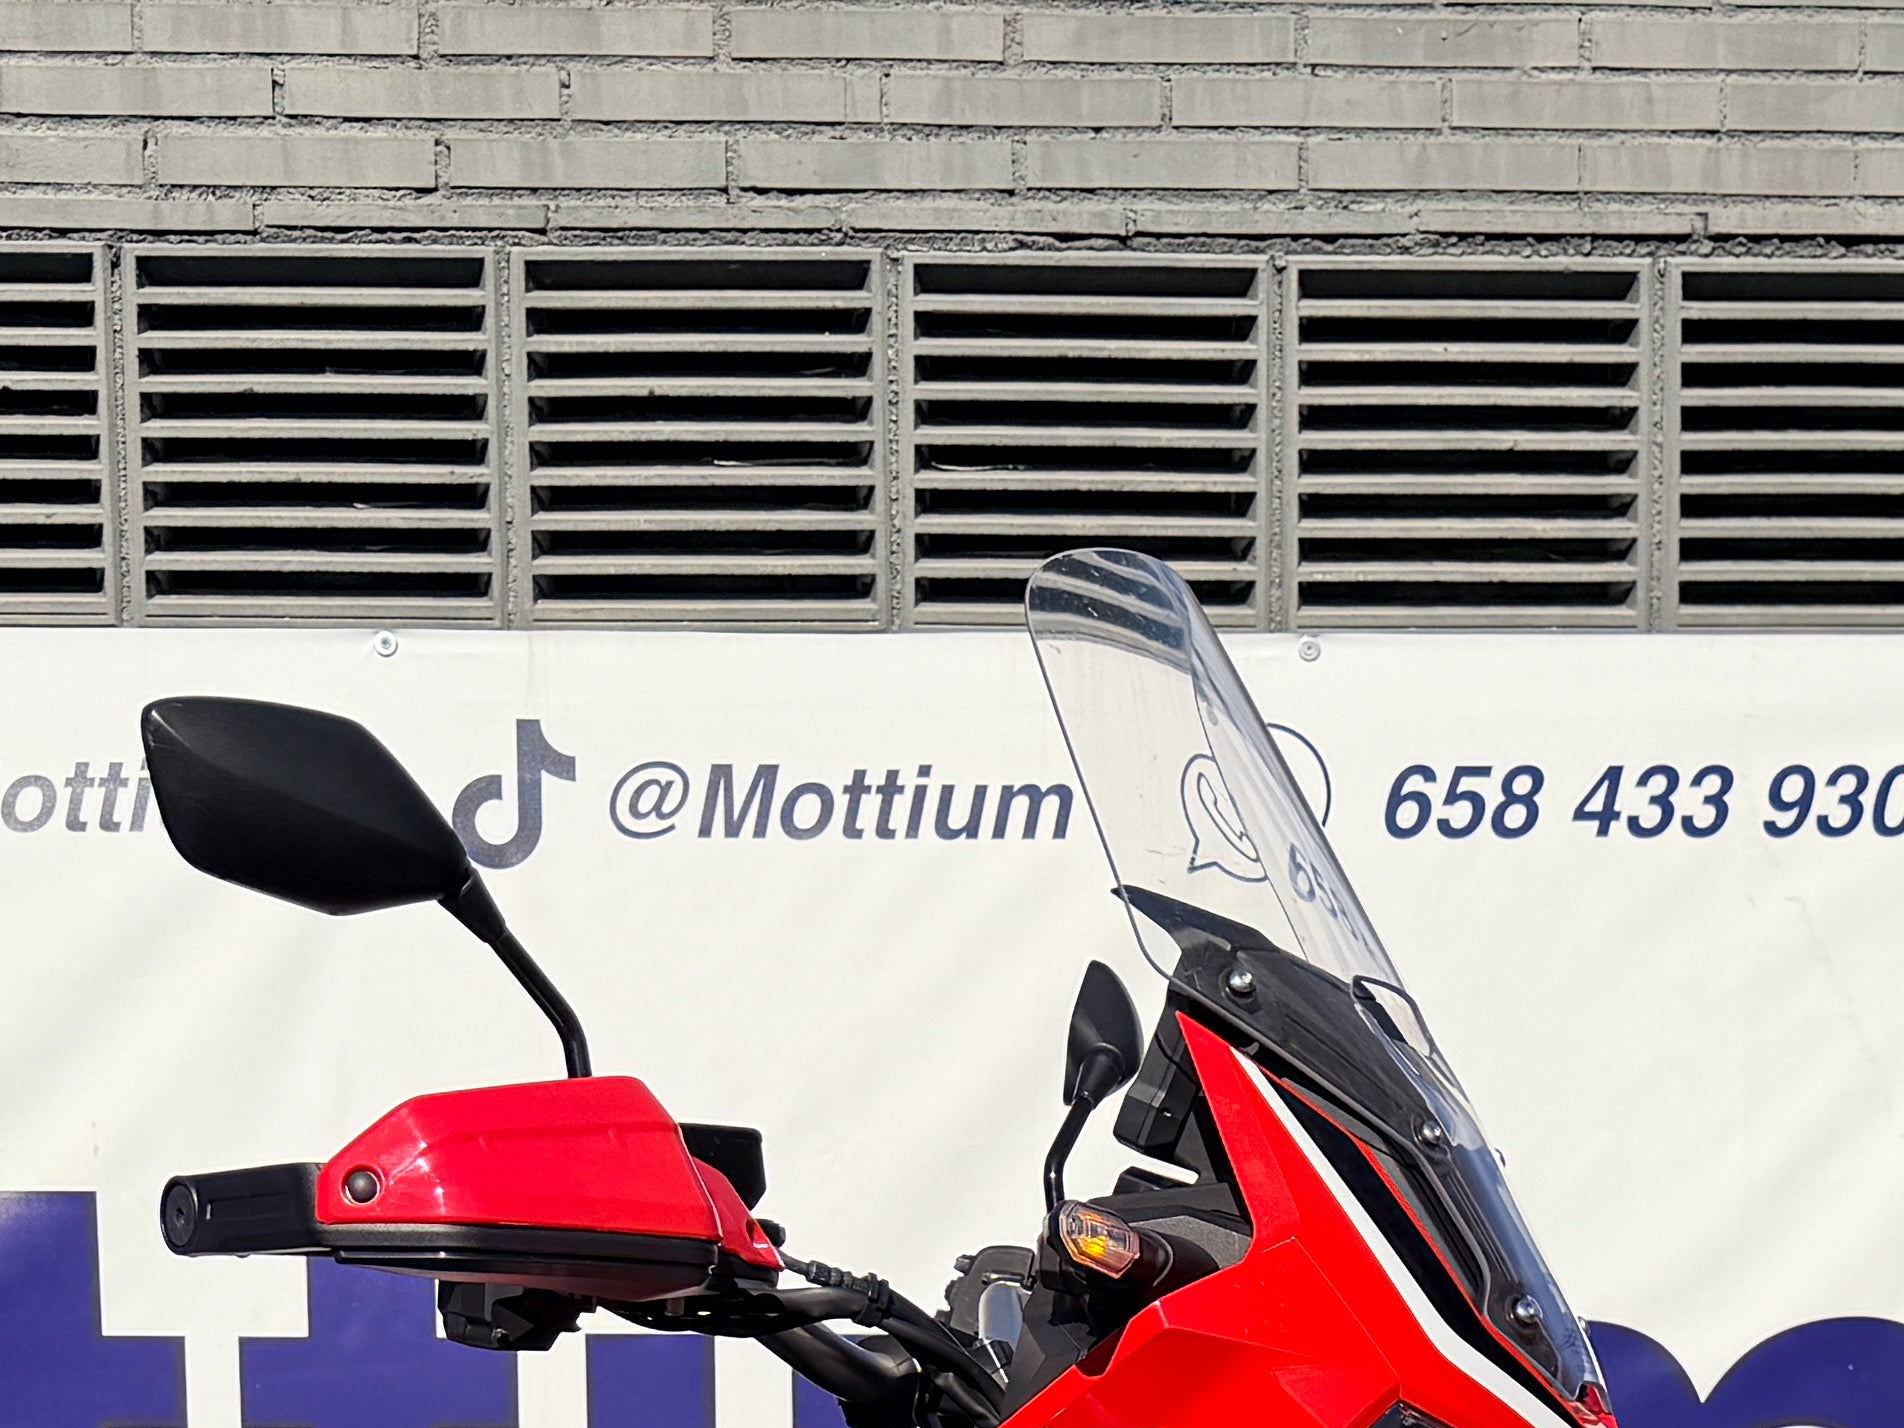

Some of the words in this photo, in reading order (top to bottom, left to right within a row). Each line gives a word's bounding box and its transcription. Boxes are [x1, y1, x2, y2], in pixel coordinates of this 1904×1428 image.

[608, 758, 1072, 842] @Mottium
[1384, 764, 1546, 841] 658
[1572, 764, 1736, 841] 433
